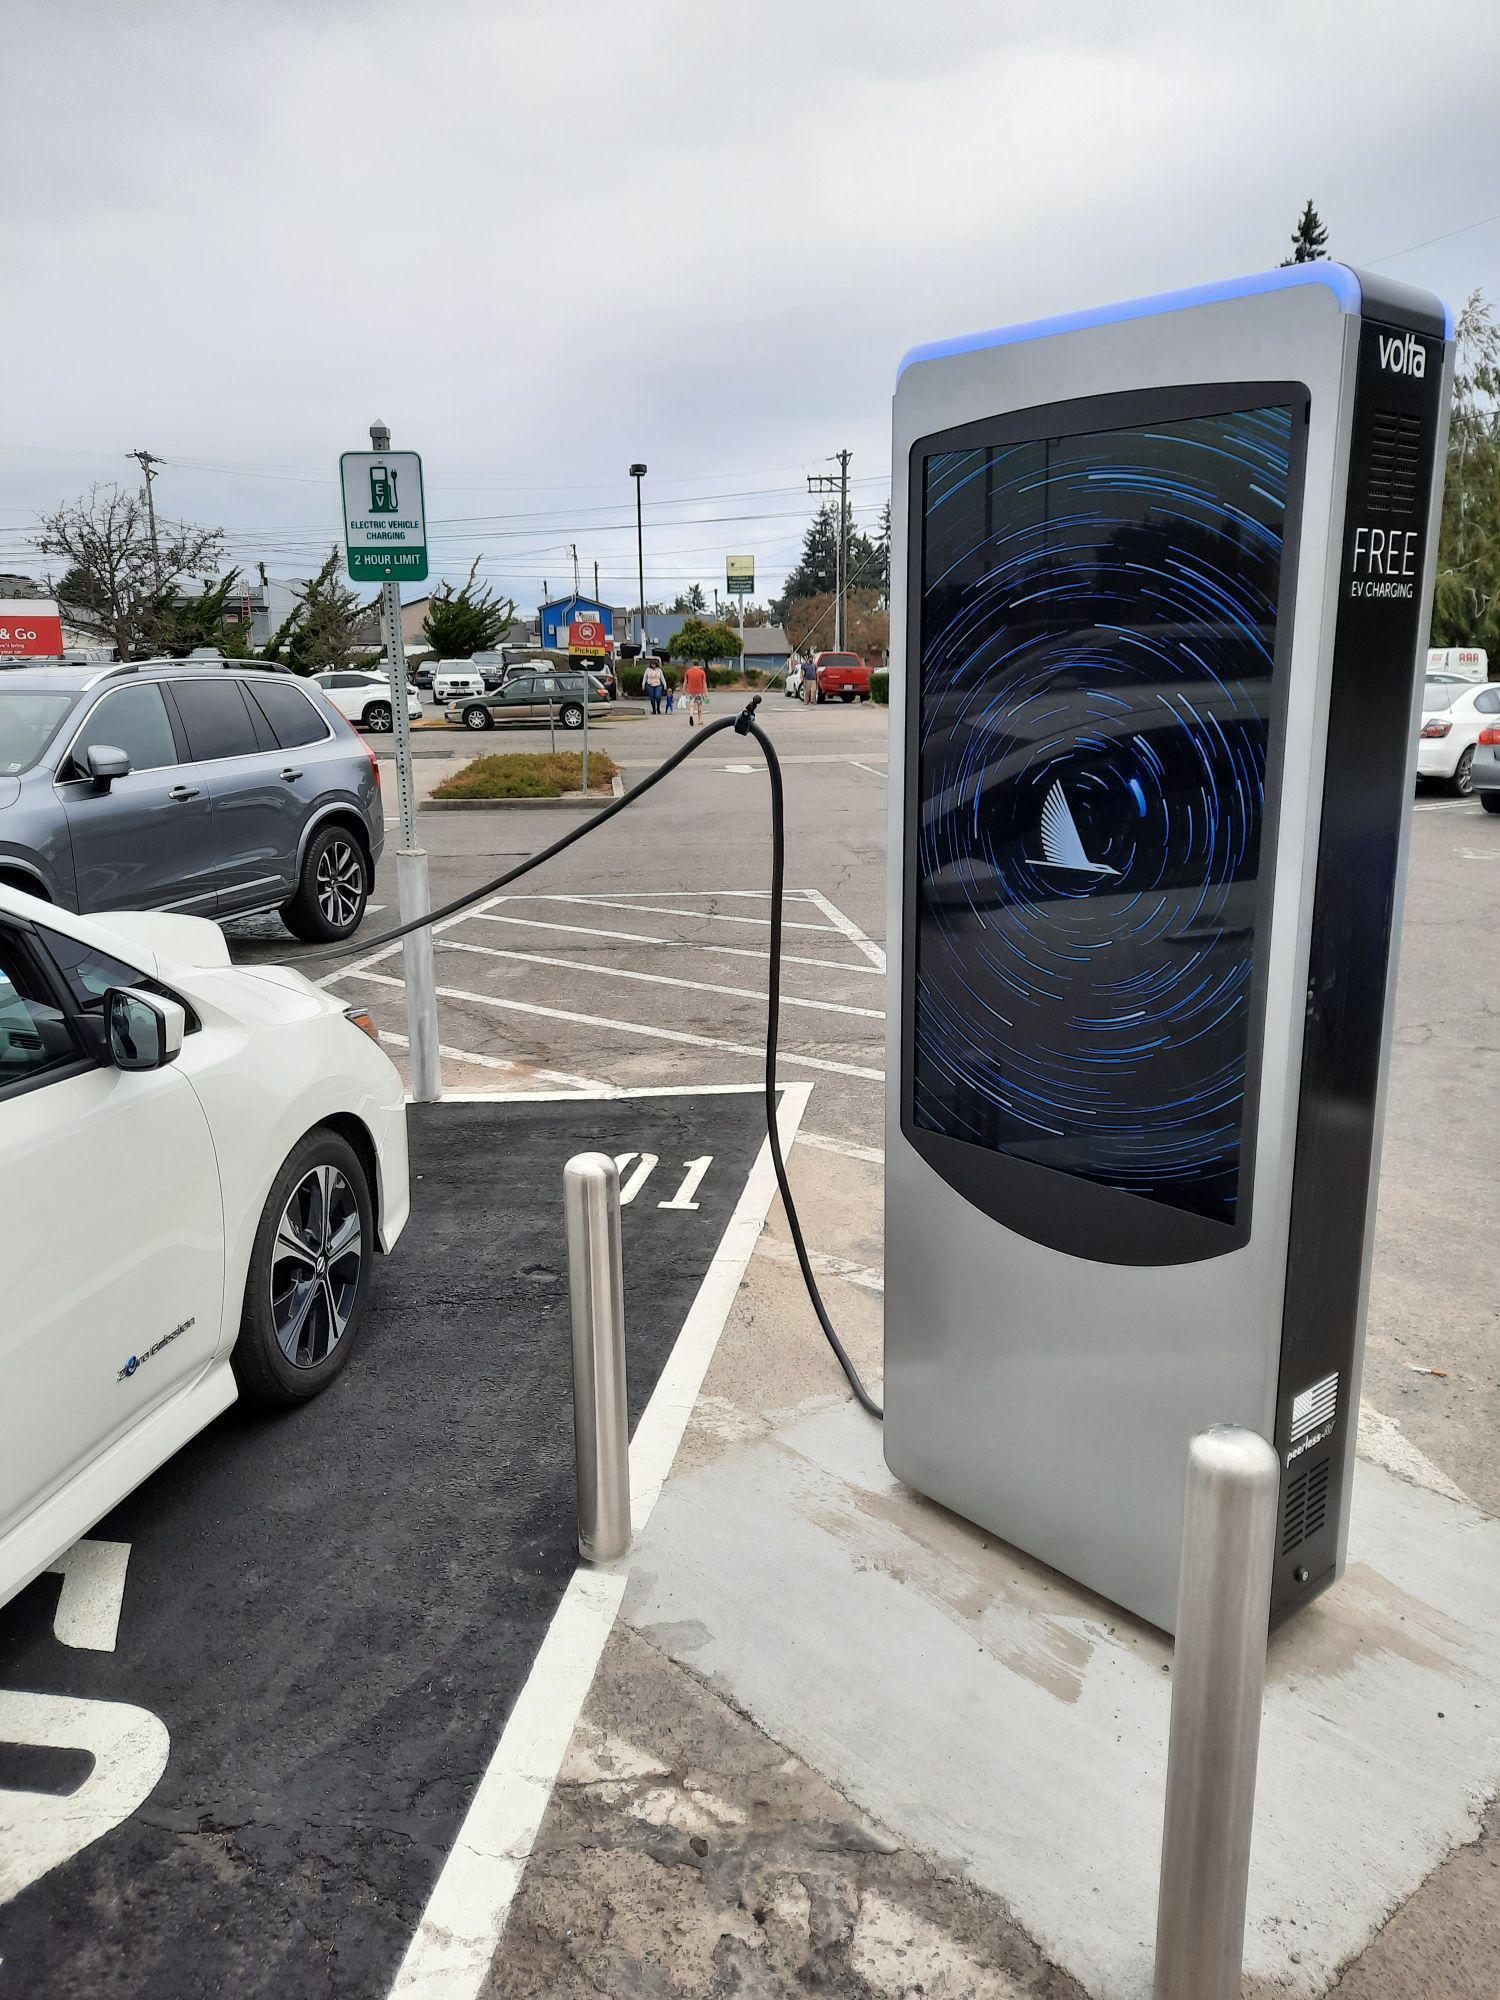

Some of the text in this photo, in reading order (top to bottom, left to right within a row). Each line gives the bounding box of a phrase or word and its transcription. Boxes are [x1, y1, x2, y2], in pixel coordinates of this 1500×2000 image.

[1379, 333, 1425, 378] volta
[351, 520, 419, 529] ELECTRIC VEHICLE
[366, 532, 405, 540] CHARGING
[1353, 528, 1418, 575] FREE
[354, 554, 420, 565] 2 HOUR LIMIT
[1351, 581, 1413, 598] EV CHARGING
[0, 628, 37, 640] & Go
[574, 647, 599, 656] Pickup
